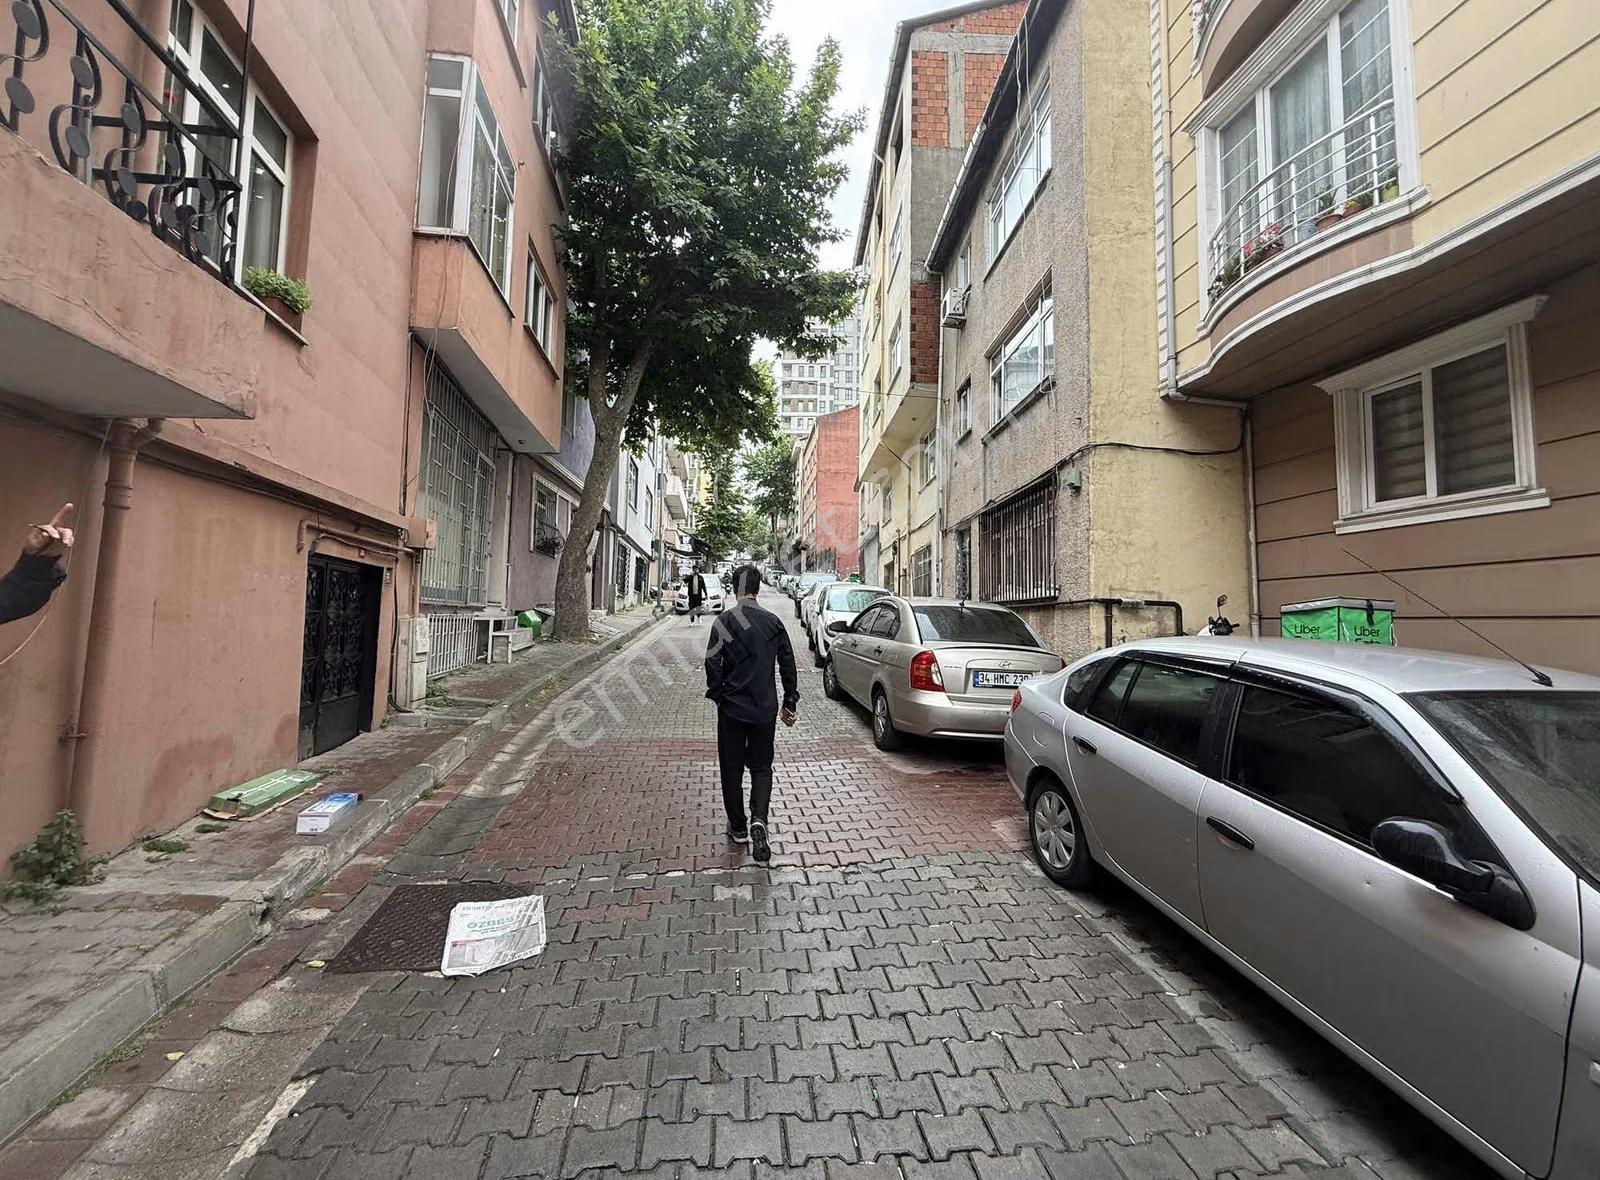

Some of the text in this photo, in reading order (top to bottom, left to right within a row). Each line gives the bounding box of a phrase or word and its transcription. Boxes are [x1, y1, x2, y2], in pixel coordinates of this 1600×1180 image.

[1294, 624, 1321, 634] Uber
[1354, 626, 1380, 637] Uber
[979, 673, 990, 684] 34
[993, 674, 1010, 685] HMC
